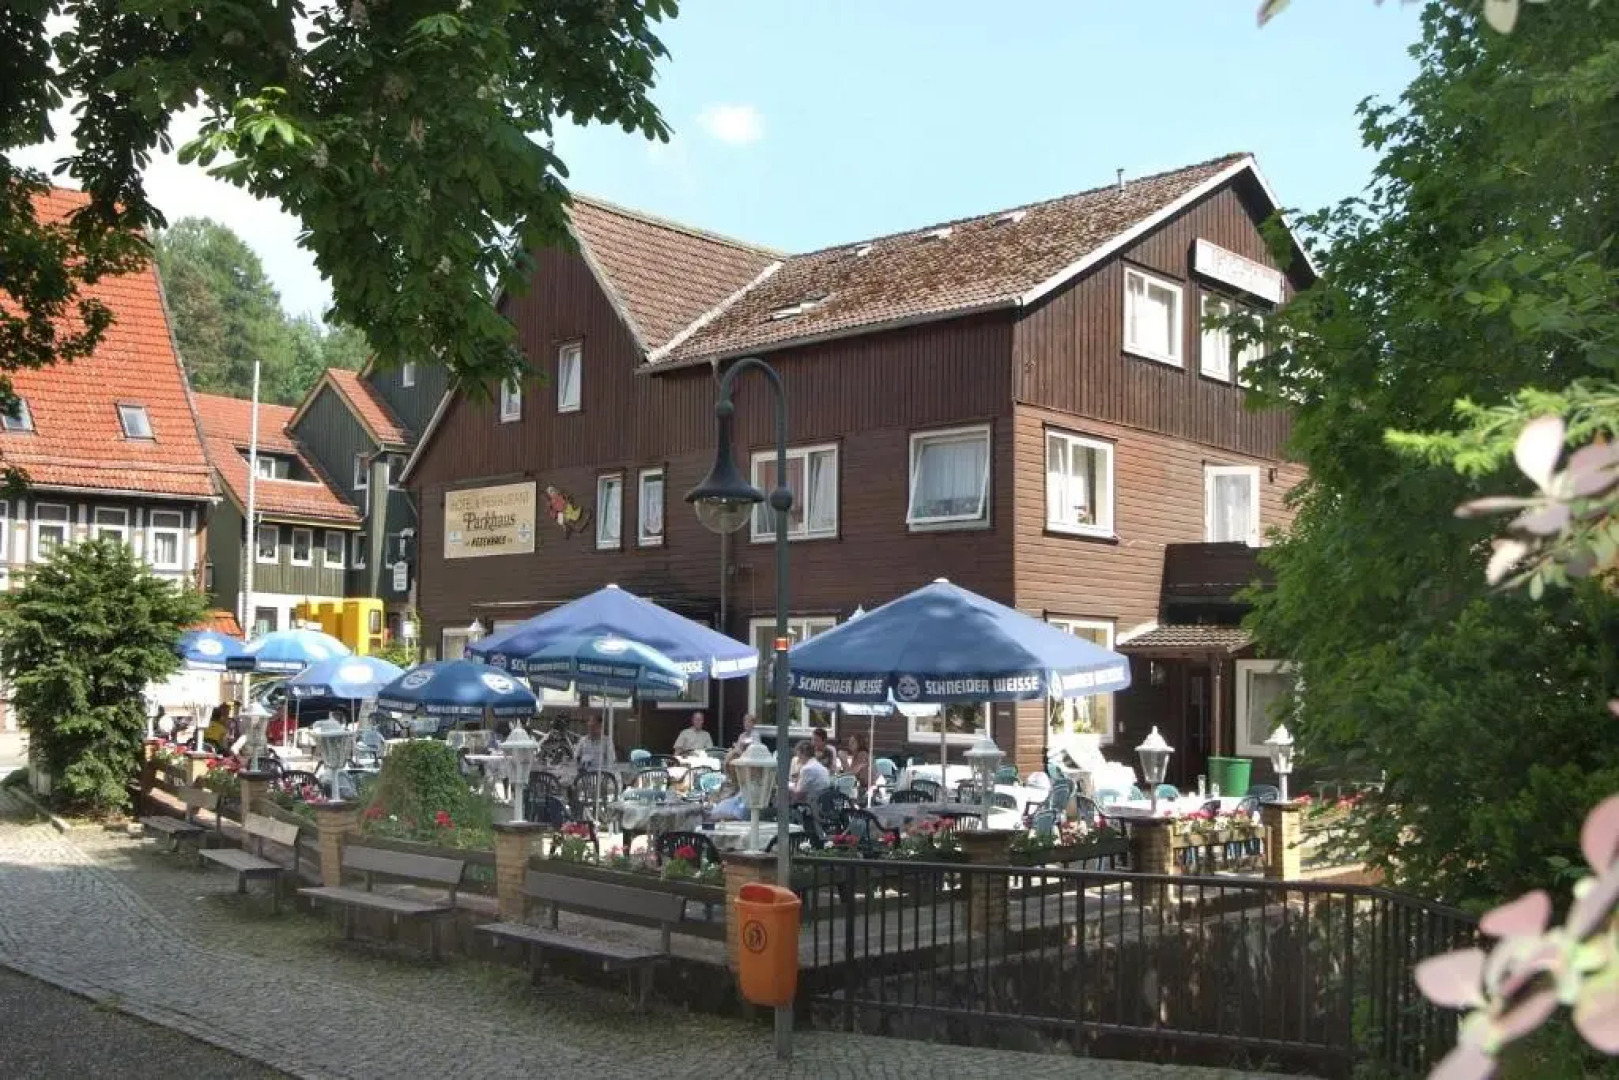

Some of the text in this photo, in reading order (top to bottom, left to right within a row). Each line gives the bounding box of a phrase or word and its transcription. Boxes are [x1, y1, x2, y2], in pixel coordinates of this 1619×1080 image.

[463, 511, 516, 531] Parkhaus
[798, 676, 884, 695] SCHNEIDER WEISSE
[925, 676, 1040, 695] SCHNEIDER WEISSE
